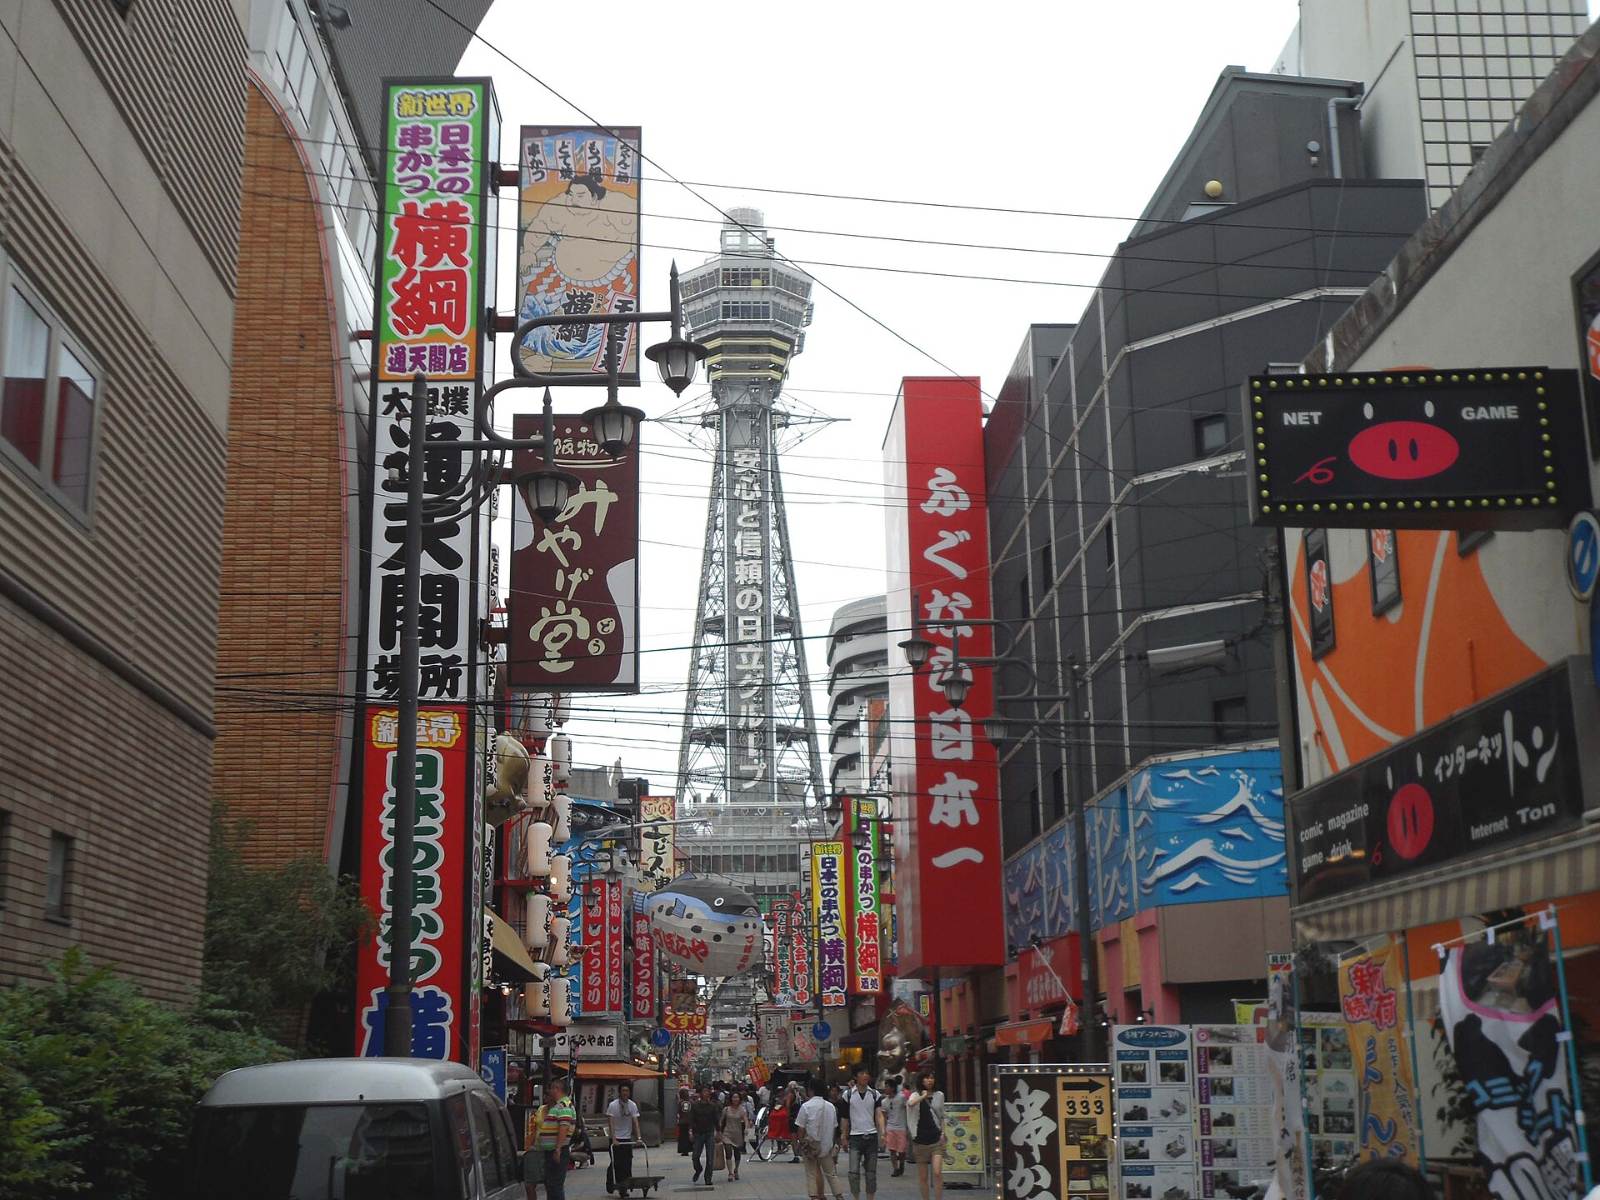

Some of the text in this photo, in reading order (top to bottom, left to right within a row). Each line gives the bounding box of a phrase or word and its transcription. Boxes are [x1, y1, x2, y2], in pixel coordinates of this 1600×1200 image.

[398, 92, 474, 116] 新世界
[396, 125, 433, 195] 串かつ
[436, 125, 471, 194] 日本一の
[527, 142, 546, 182] 串かつ
[392, 202, 470, 336] 横綱
[386, 344, 469, 373] 通天閣店
[1282, 411, 1322, 425] NET
[1461, 406, 1519, 420] GAME
[734, 447, 767, 790] 安心と信頼の日立グループ
[374, 654, 462, 698] 場所
[1300, 803, 1369, 842] comic magazine
[1471, 802, 1556, 840] Internet Ton
[813, 844, 843, 856] 新世界
[1302, 851, 1323, 872] game
[821, 856, 839, 937] 日本一の串かつ
[857, 912, 880, 974] 横綱
[821, 938, 846, 991] 横綱
[665, 1013, 705, 1030] くすり
[739, 1019, 759, 1039] 味
